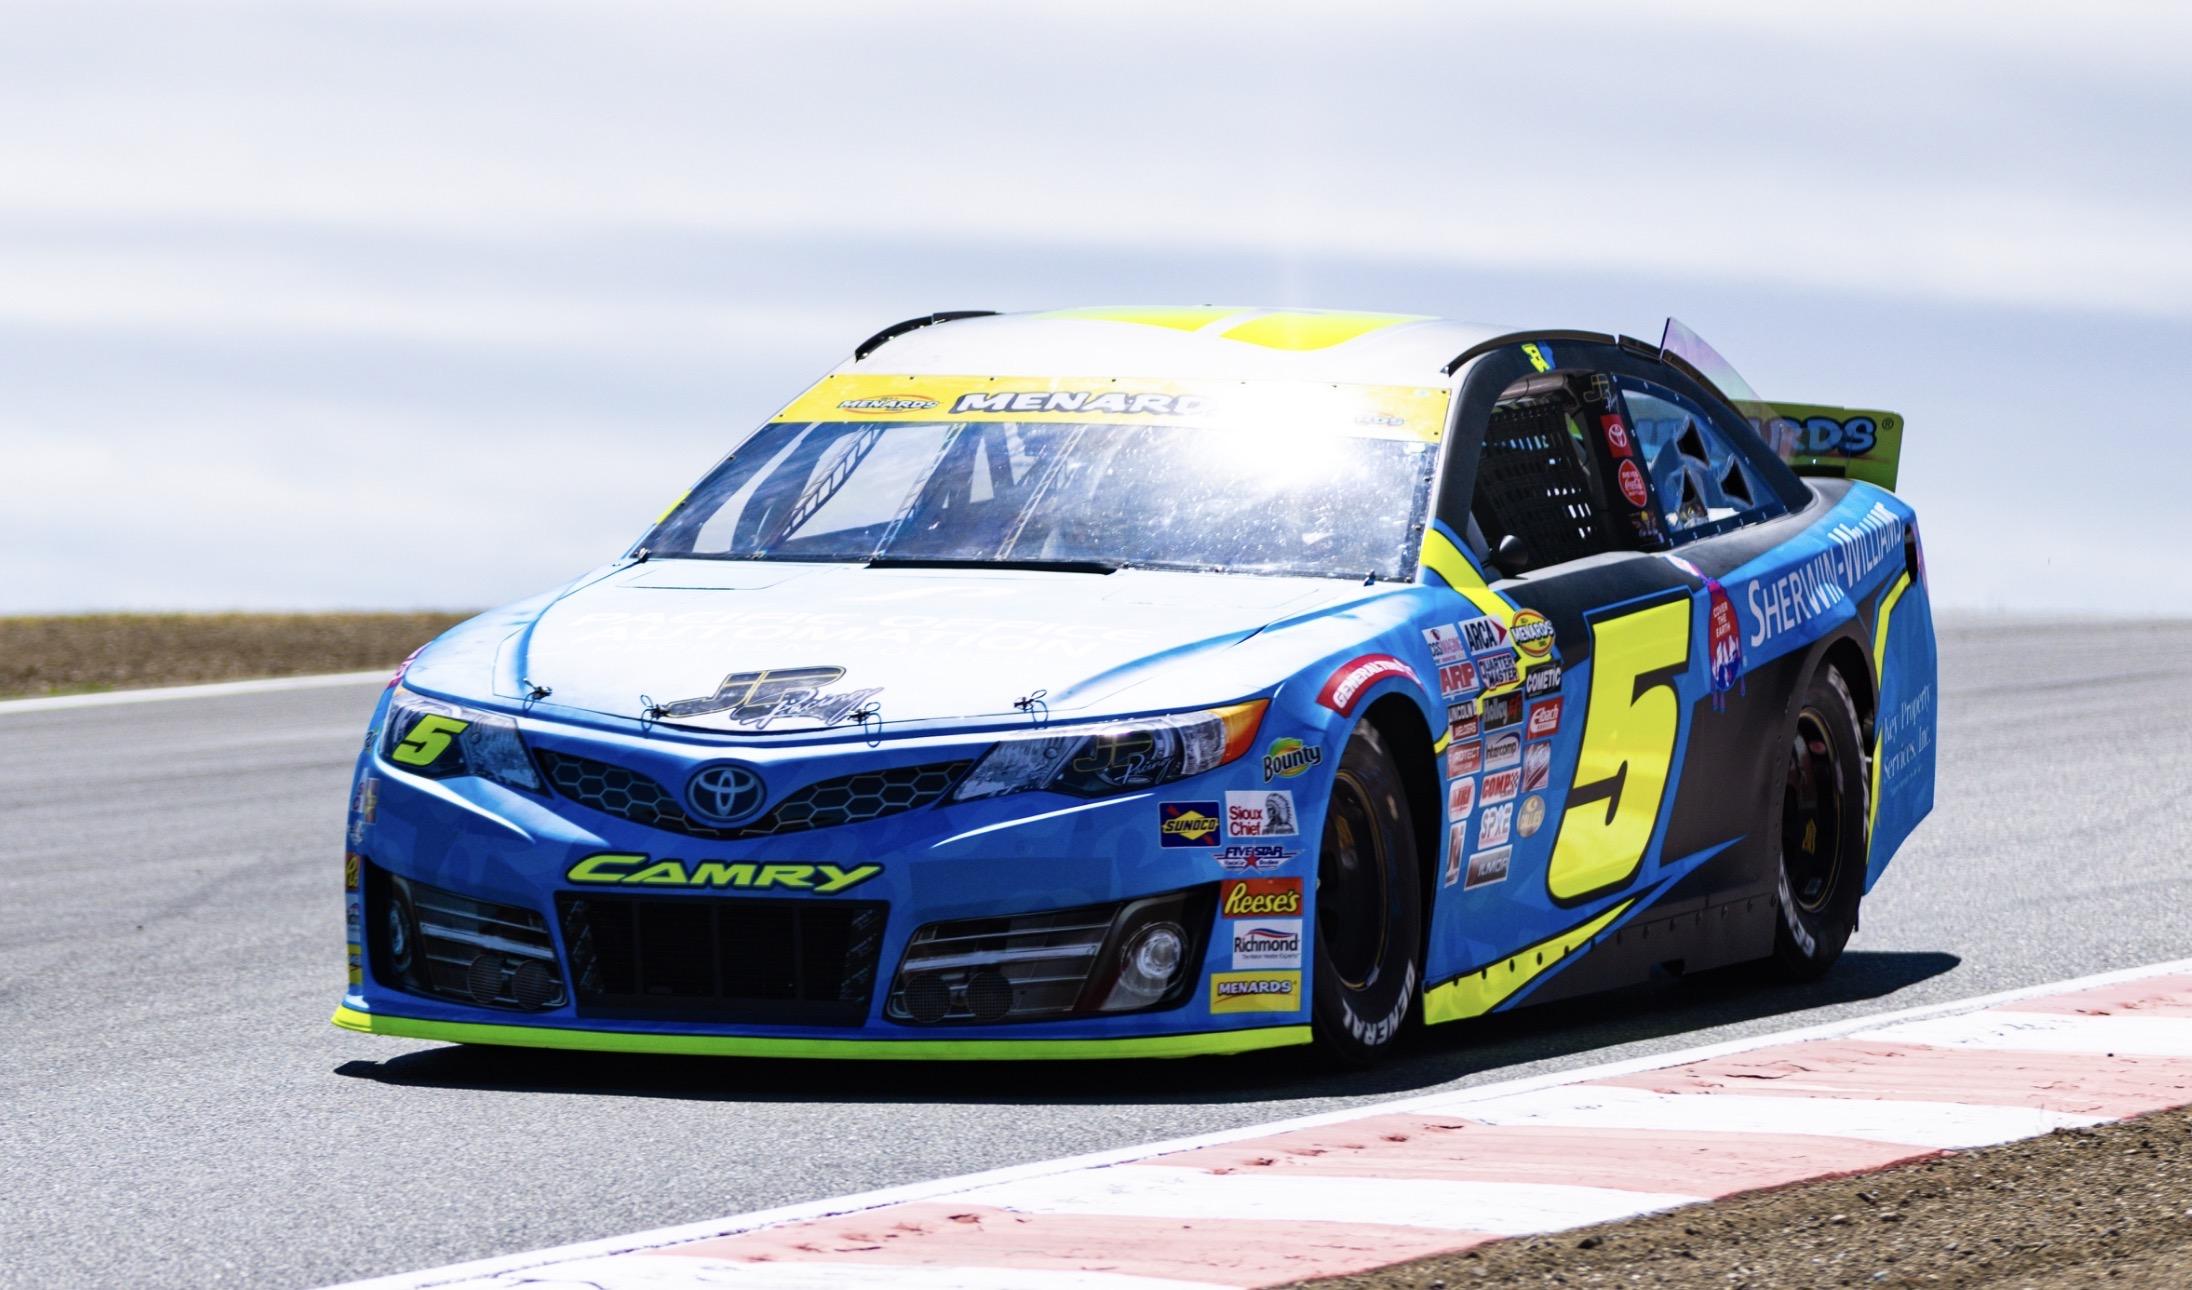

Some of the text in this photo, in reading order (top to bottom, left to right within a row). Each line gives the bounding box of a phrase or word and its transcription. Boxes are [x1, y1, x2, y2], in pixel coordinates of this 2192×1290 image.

[837, 398, 940, 409] MENARDS
[949, 392, 1217, 414] MENARD
[1464, 620, 1498, 652] ARCA
[1510, 620, 1554, 644] MENARDS
[1440, 662, 1475, 692] ARP
[1486, 667, 1518, 688] MASTER
[1526, 667, 1562, 693] COMETIC
[392, 713, 470, 766] 5
[1548, 598, 1690, 900] 5
[1264, 744, 1321, 783] Bounty
[1229, 805, 1264, 820] Sioux
[1163, 819, 1218, 833] SUNOCO
[1229, 821, 1261, 836] Chief
[1225, 846, 1284, 858] FIVE STAR
[567, 854, 881, 892] CAMRY
[1223, 882, 1300, 915] Reese's
[1234, 934, 1299, 953] Richmond
[1218, 980, 1293, 994] MENARDS
